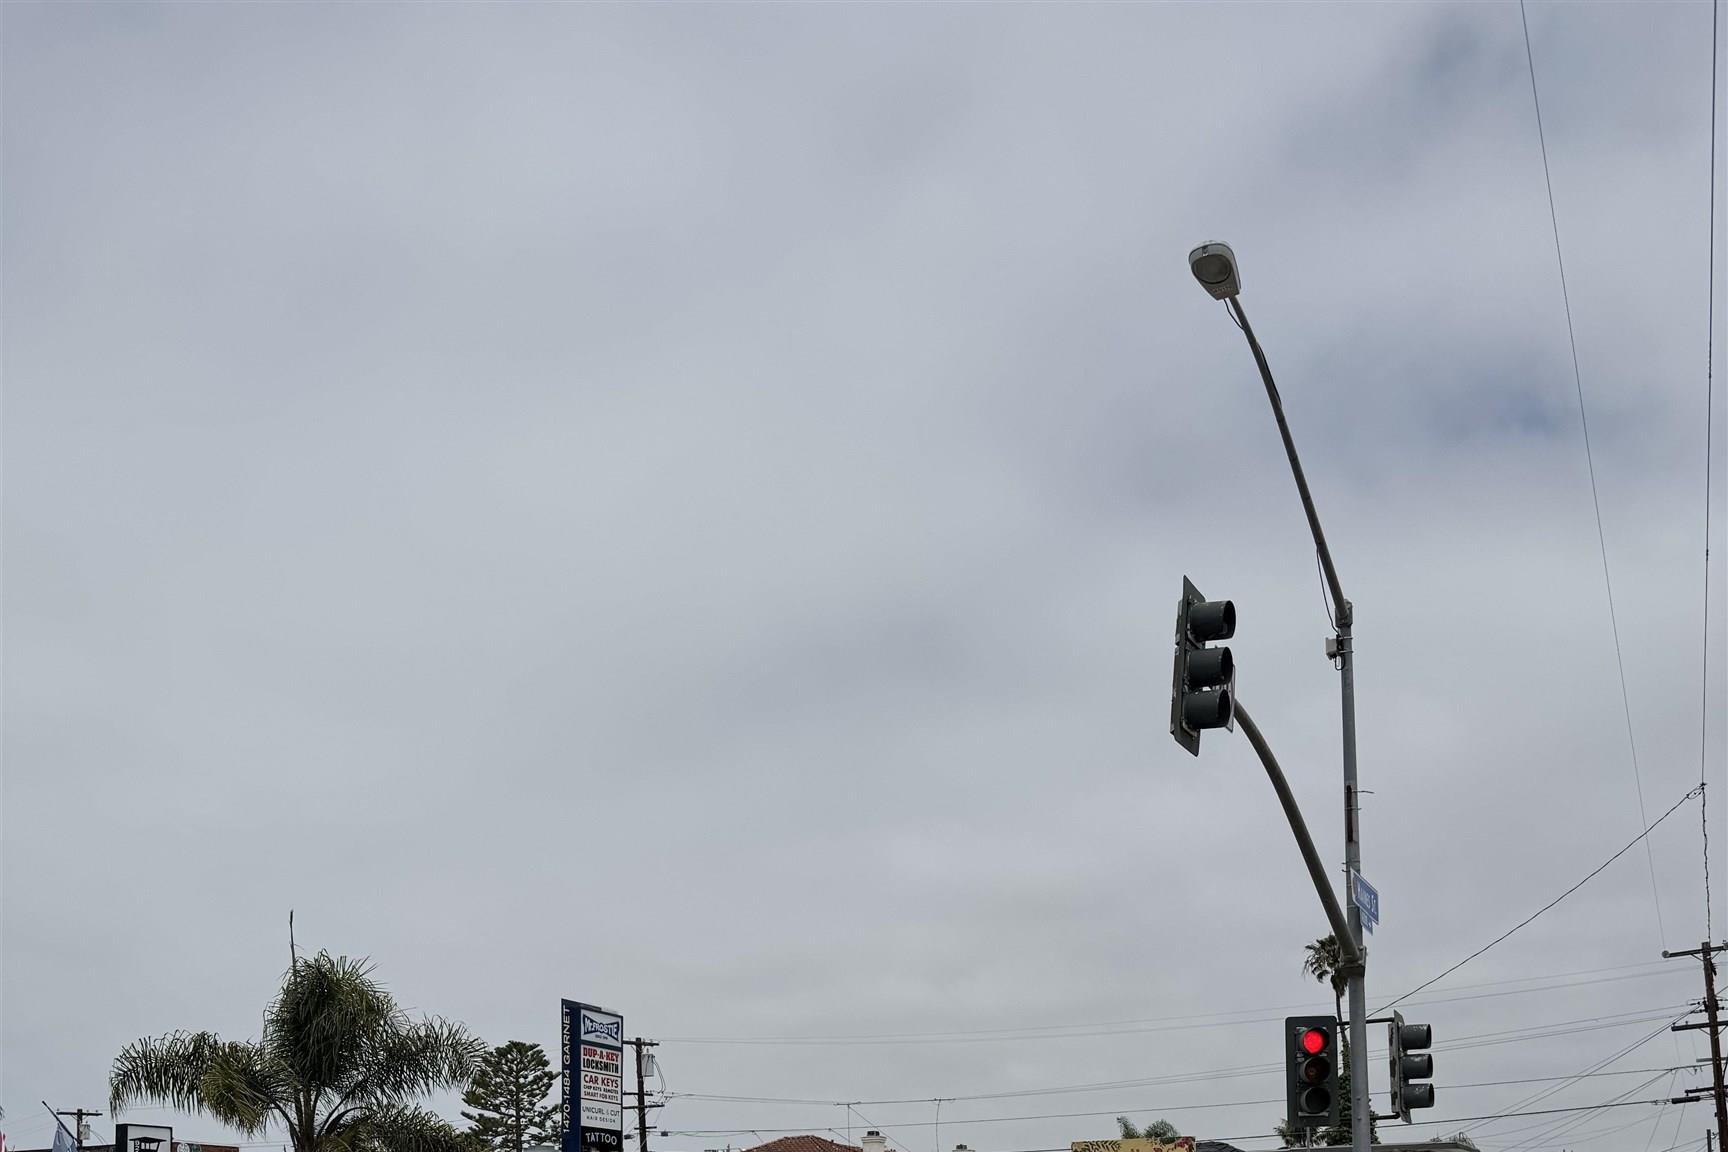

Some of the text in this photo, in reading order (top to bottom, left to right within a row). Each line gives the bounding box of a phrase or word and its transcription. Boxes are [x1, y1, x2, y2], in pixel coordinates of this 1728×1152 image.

[563, 1005, 571, 1133] 1470-1484 GARNET
[583, 1057, 618, 1073] LOCKSMITH
[584, 1074, 618, 1088] CAR KEYS
[582, 1105, 605, 1115] UNICURL
[610, 1109, 620, 1117] CUT
[585, 1132, 618, 1145] TATTOO
